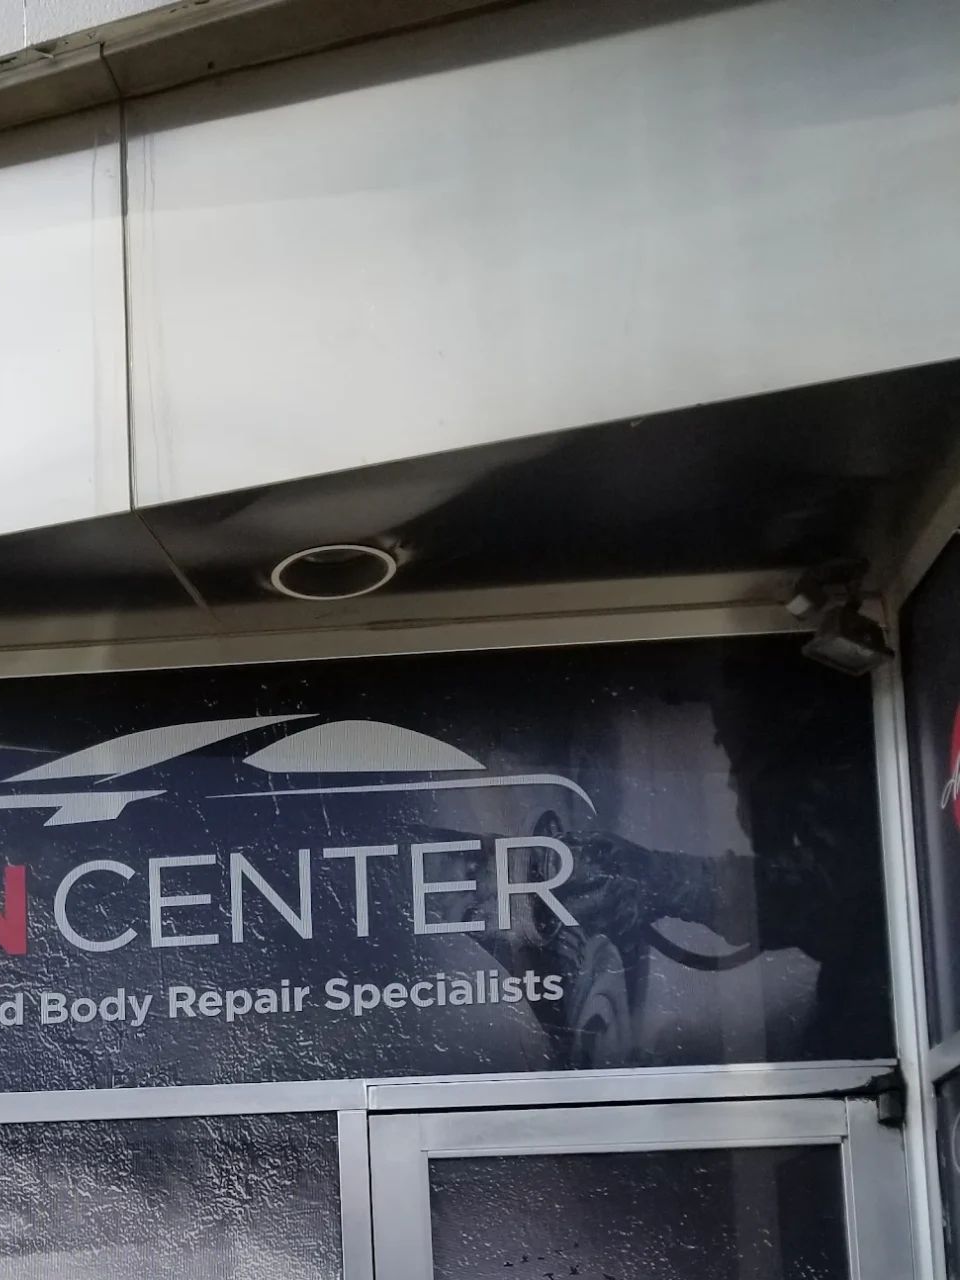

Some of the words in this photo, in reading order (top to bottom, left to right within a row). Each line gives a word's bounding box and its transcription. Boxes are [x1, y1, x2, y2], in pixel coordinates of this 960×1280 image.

[53, 836, 581, 952] CENTER
[40, 988, 152, 1026] Body
[169, 979, 310, 1022] Repair
[325, 968, 564, 1015] Specialists
